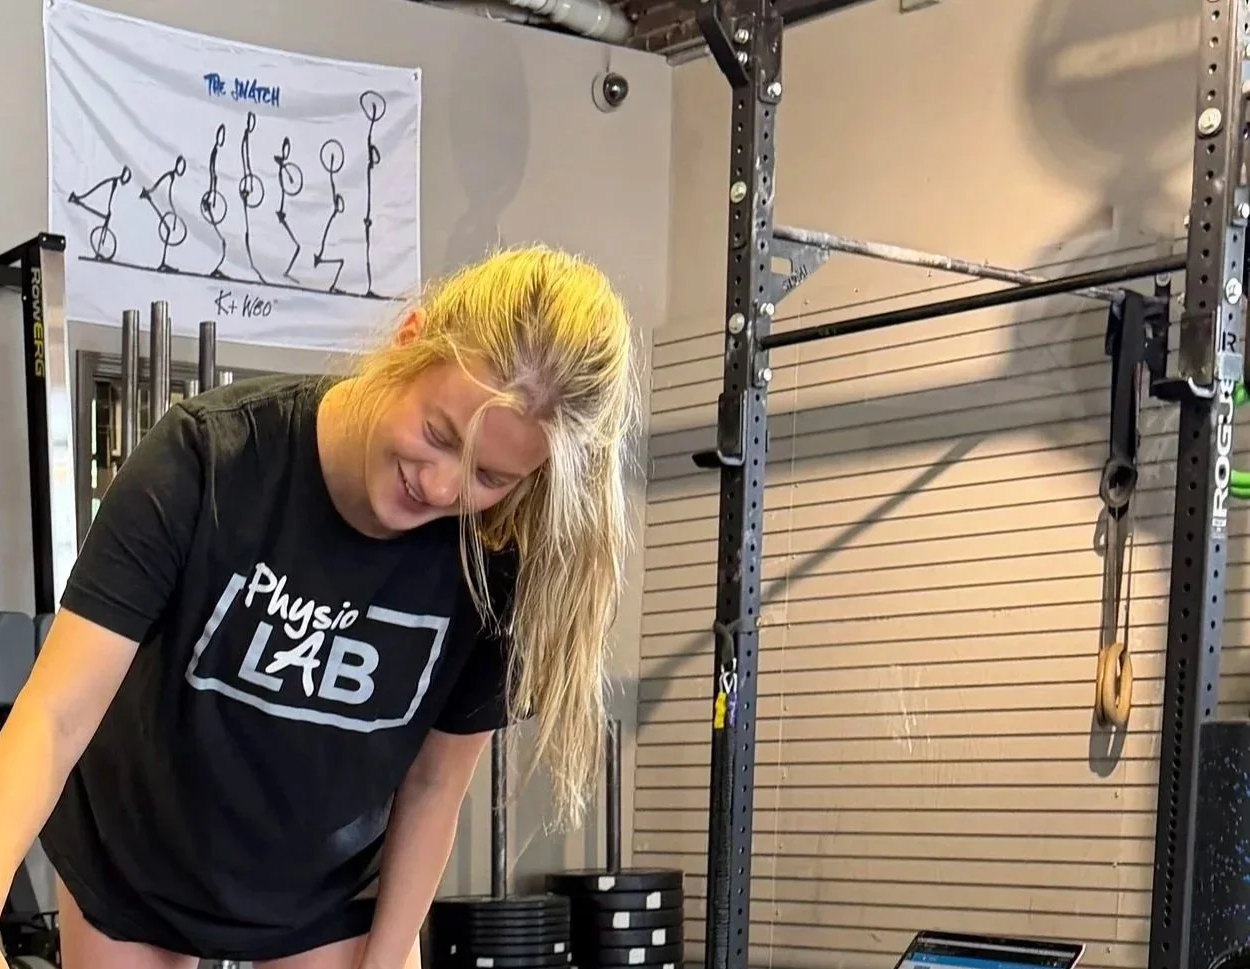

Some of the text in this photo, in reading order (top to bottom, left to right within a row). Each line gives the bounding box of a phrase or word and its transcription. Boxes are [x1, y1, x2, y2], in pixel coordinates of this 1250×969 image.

[231, 77, 280, 108] SNATCH
[244, 562, 359, 640] Physio
[238, 621, 380, 705] LAB
